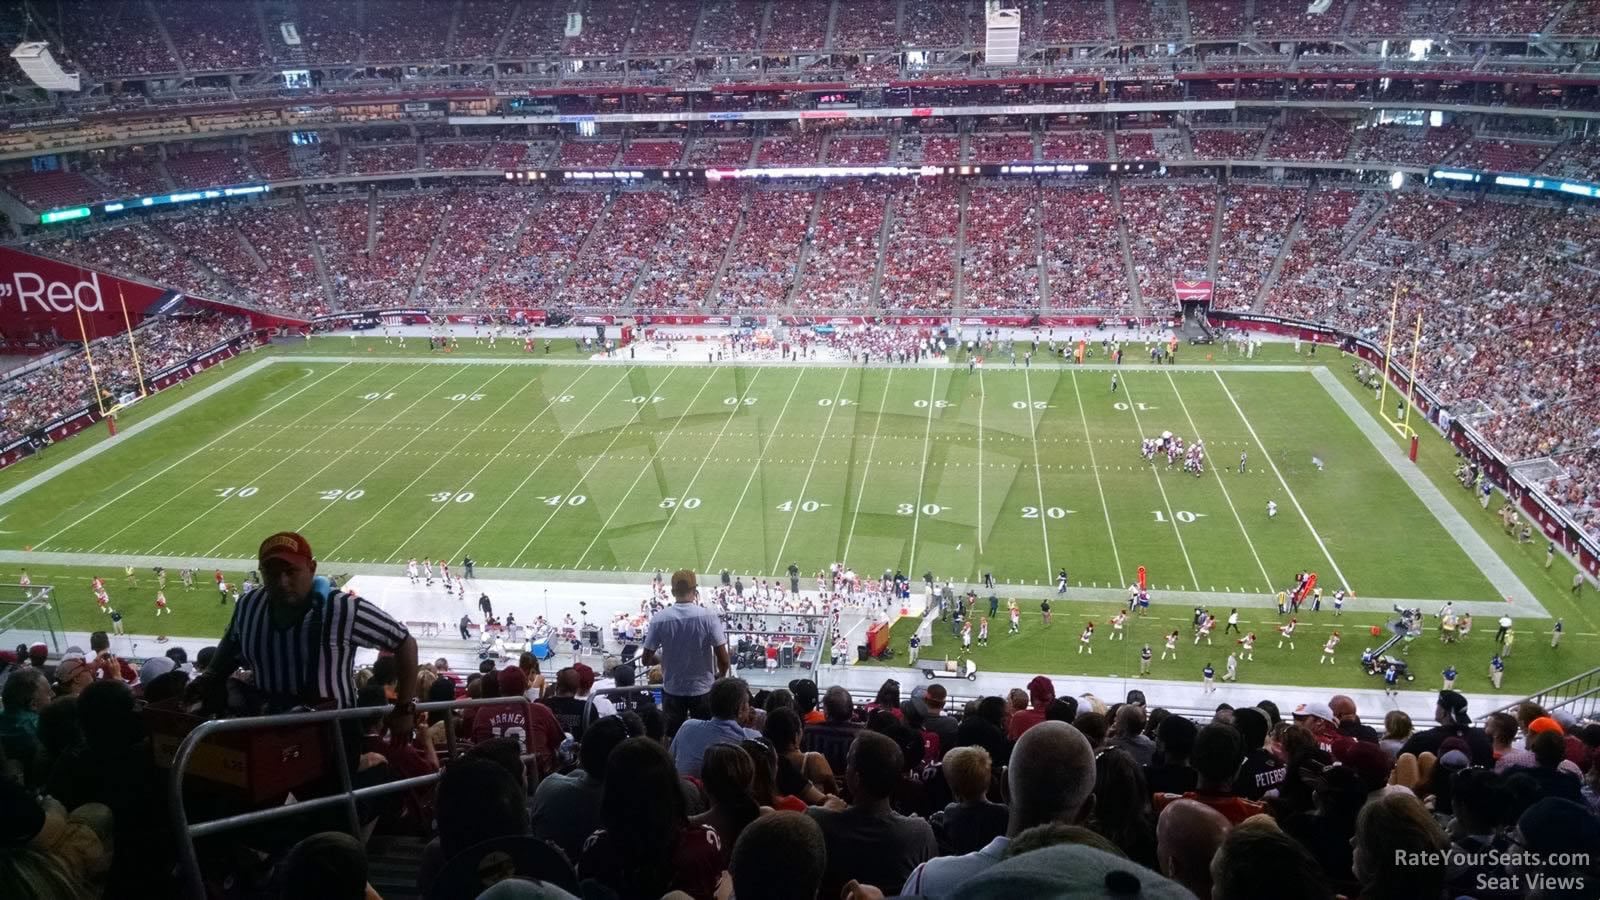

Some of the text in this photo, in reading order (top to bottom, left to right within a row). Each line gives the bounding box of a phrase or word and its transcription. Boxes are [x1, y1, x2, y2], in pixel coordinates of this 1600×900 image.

[215, 487, 259, 498] 10
[320, 489, 364, 500] 20
[431, 492, 475, 503] 30
[544, 495, 587, 506] 40
[658, 497, 701, 509] 50
[776, 501, 819, 512] 40
[897, 503, 940, 515] 30
[1021, 506, 1065, 519] 20
[1150, 510, 1196, 523] 10
